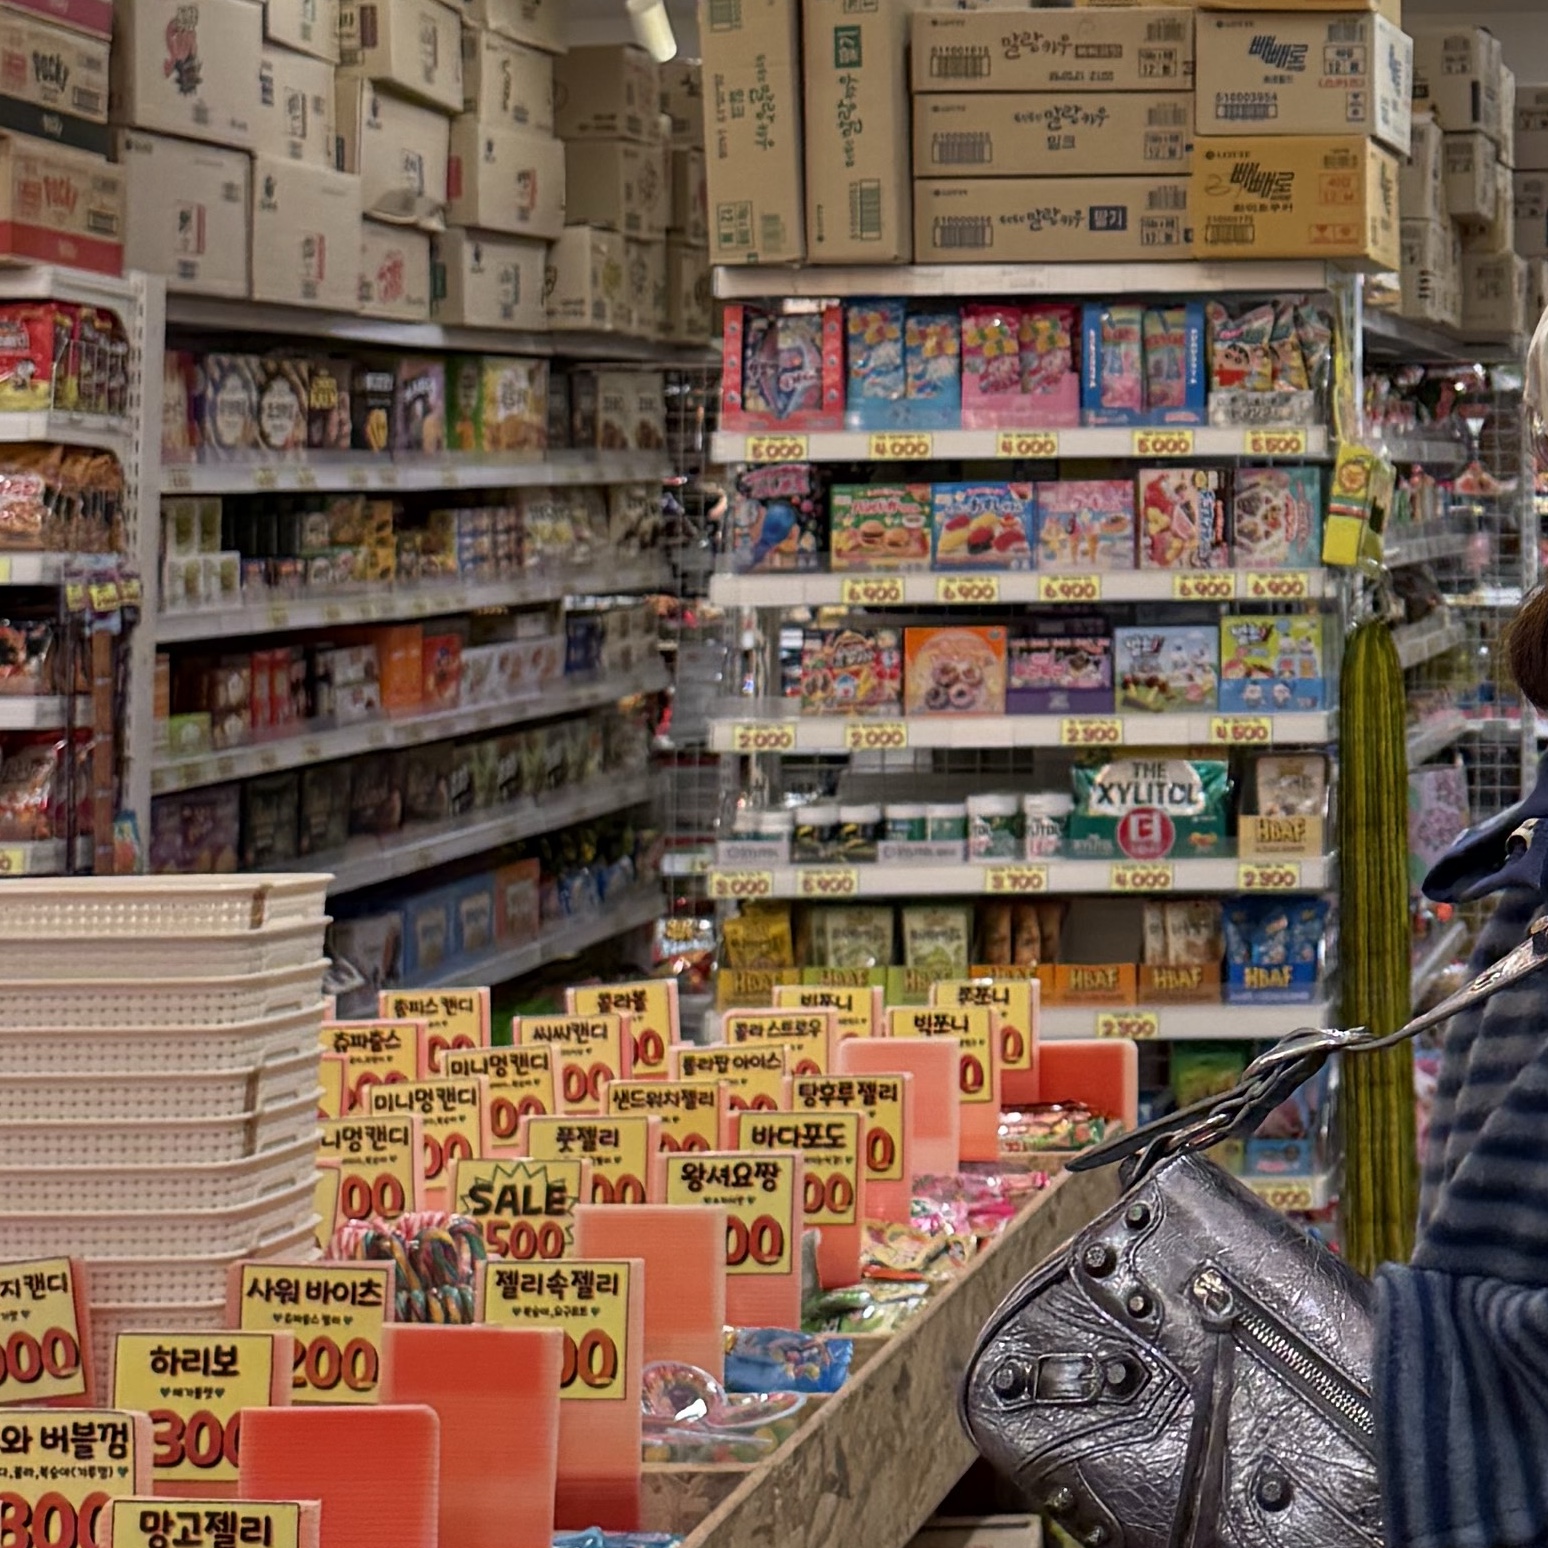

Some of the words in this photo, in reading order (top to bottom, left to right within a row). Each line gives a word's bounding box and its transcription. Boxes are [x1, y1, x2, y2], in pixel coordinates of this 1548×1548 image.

[1249, 35, 1309, 69] 빼빼로
[1230, 162, 1295, 196] 빼빼로
[1132, 762, 1168, 777] THE
[1096, 782, 1201, 804] XYLITOL
[798, 1083, 855, 1108] 탕후루
[857, 1082, 899, 1105] 젤리
[750, 1121, 848, 1150] 바다포도
[468, 1182, 567, 1218] SALE
[246, 1277, 300, 1304] 사워
[305, 1279, 384, 1308] 바이츠
[495, 1270, 620, 1298] 젤리속젤리
[149, 1344, 241, 1378] 하리보
[0, 1425, 33, 1454] 와
[40, 1421, 129, 1460] 버블껌
